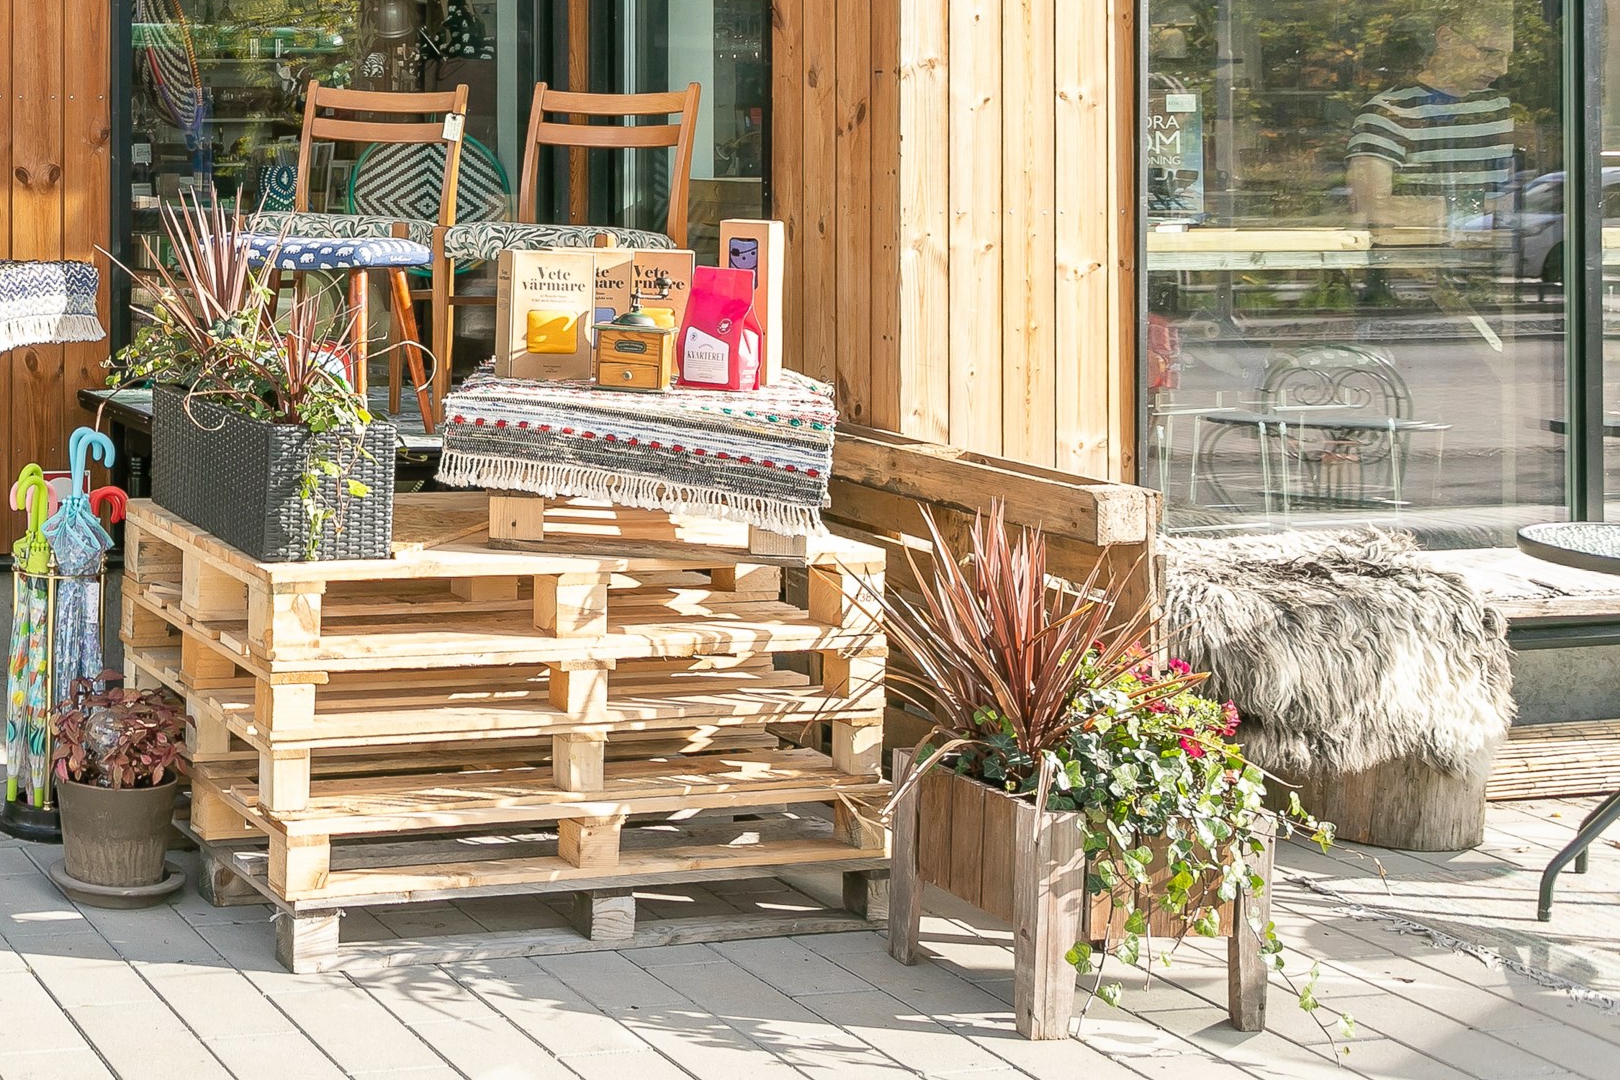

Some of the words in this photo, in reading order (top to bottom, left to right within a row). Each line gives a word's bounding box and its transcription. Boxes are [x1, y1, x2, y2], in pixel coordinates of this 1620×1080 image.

[537, 266, 571, 281] Vete
[633, 265, 669, 279] Vete
[522, 278, 586, 293] värmare
[686, 350, 725, 362] KVARTERET
